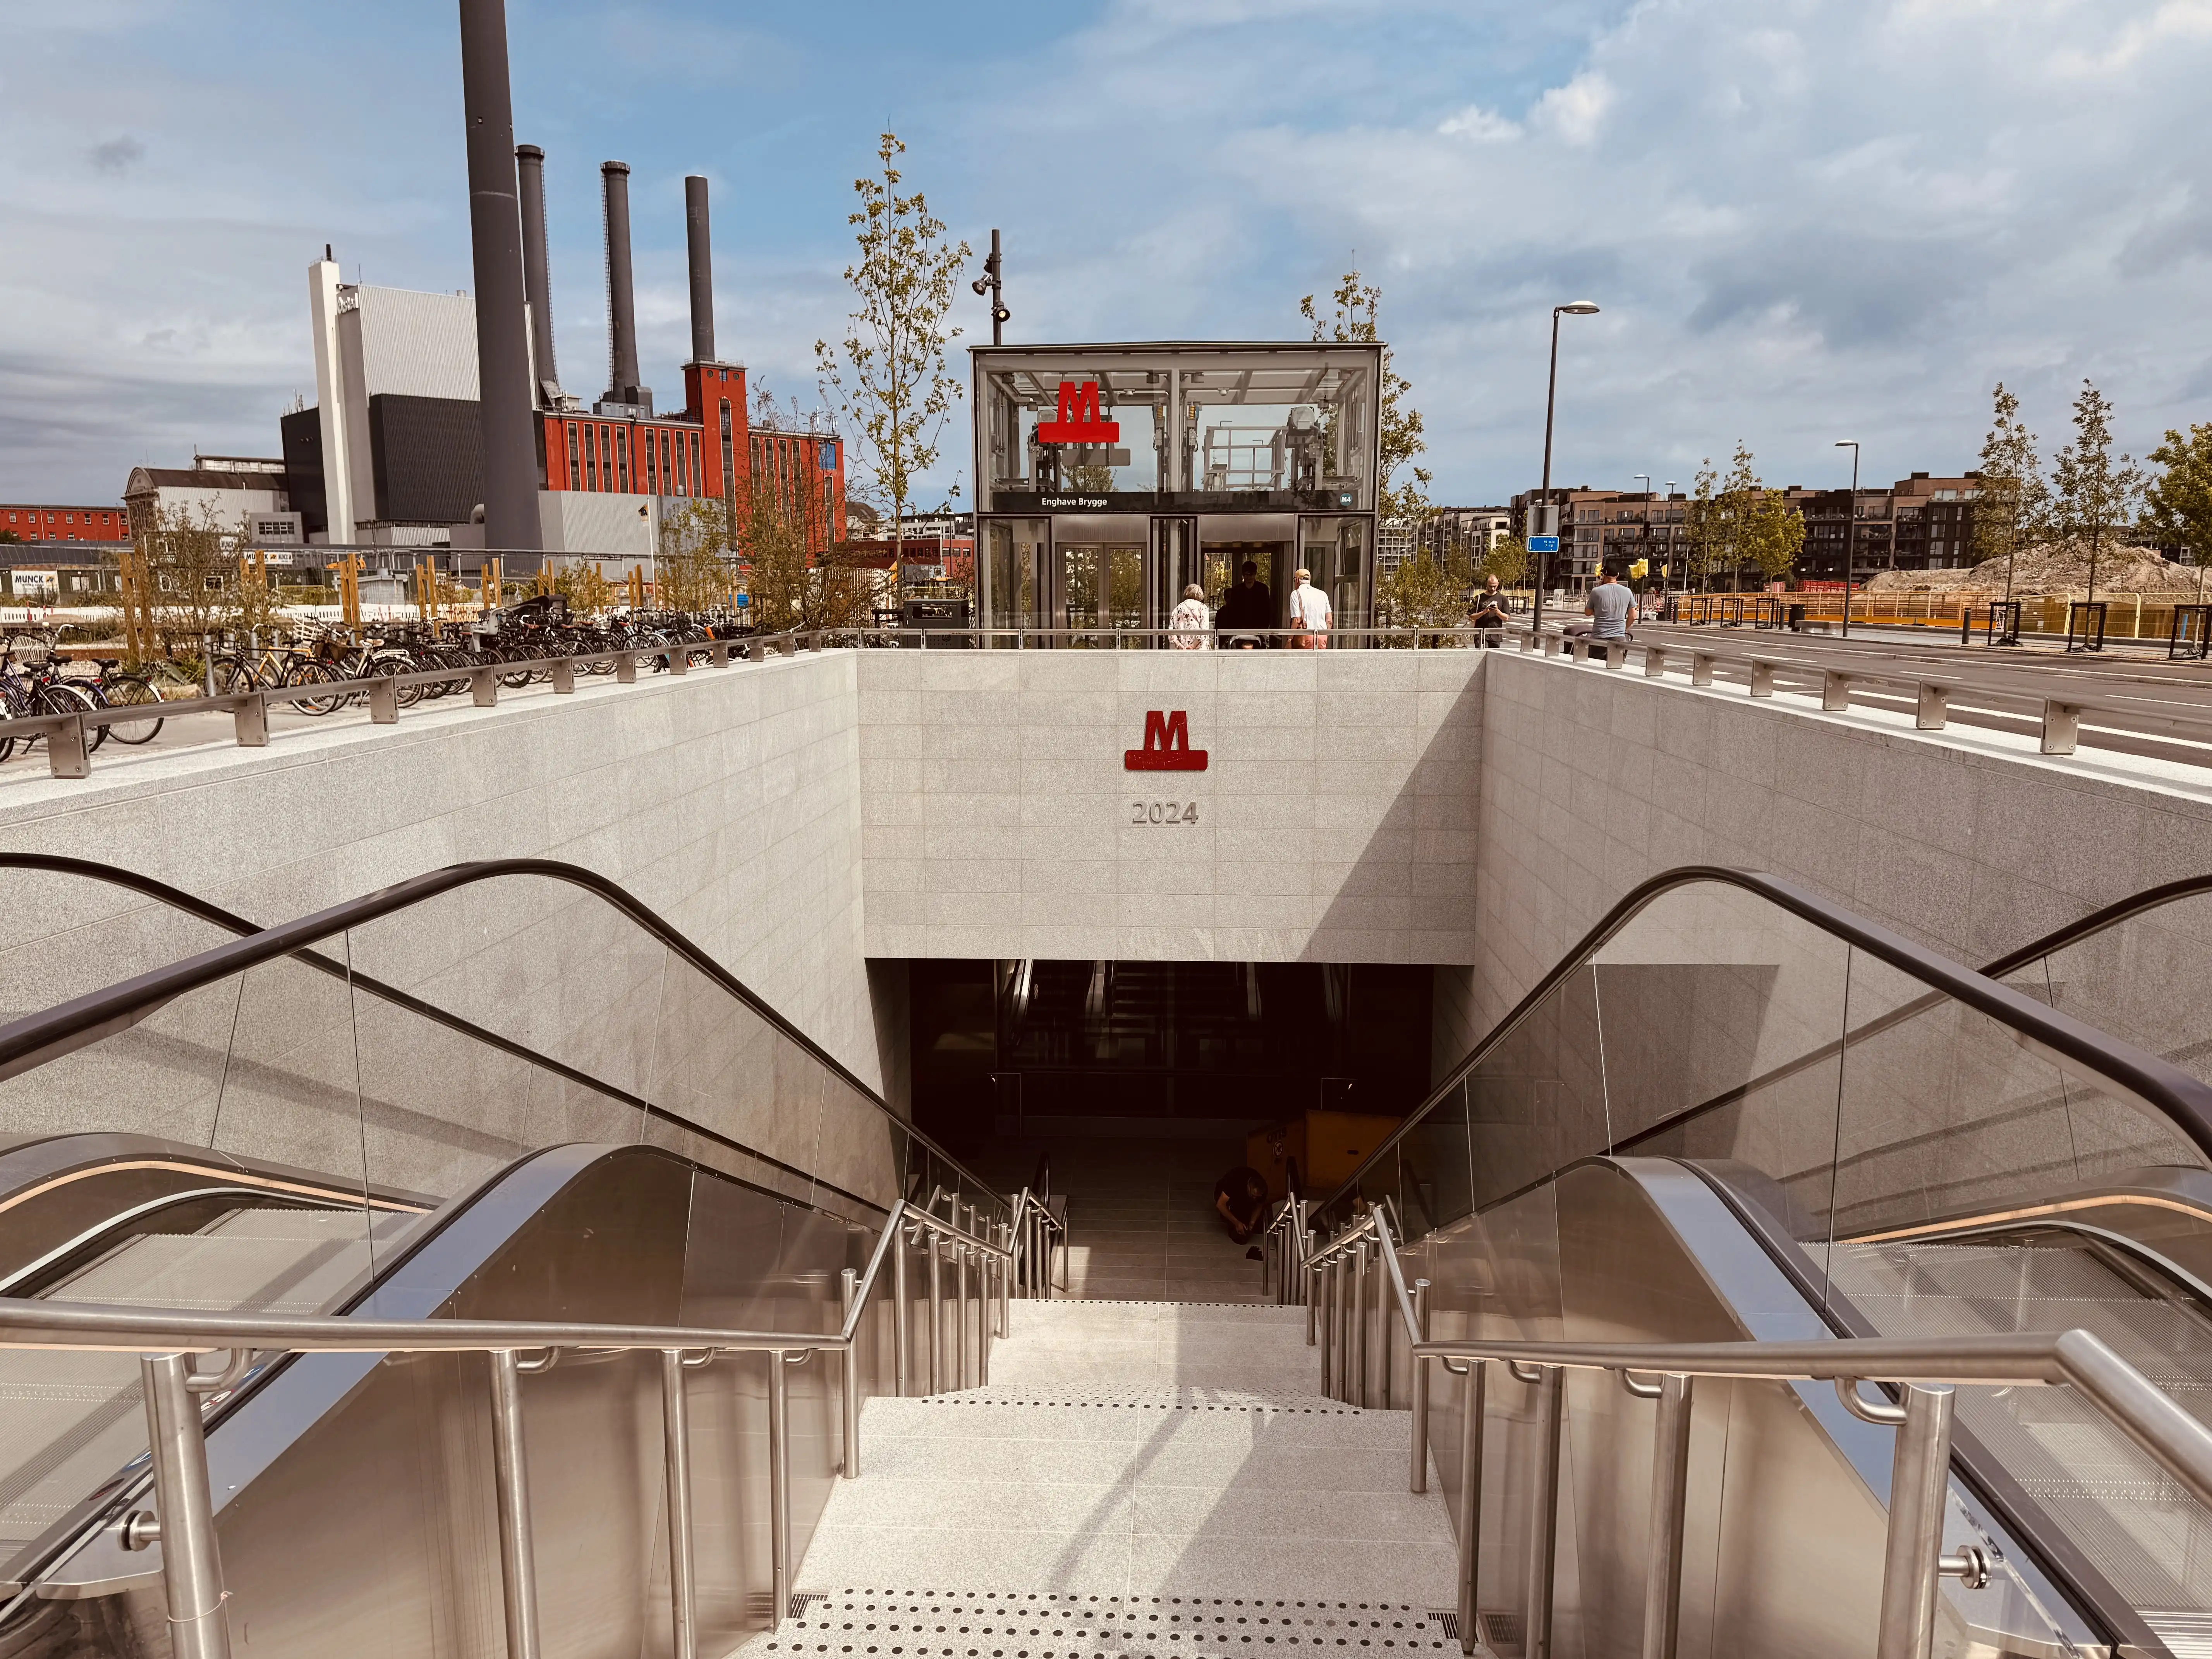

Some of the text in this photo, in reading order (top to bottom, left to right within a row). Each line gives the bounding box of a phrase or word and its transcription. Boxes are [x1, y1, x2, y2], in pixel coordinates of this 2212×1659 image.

[1042, 497, 1107, 507] Enghave Brygge
[15, 575, 44, 583] MUNCK
[1133, 800, 1198, 823] 2024
